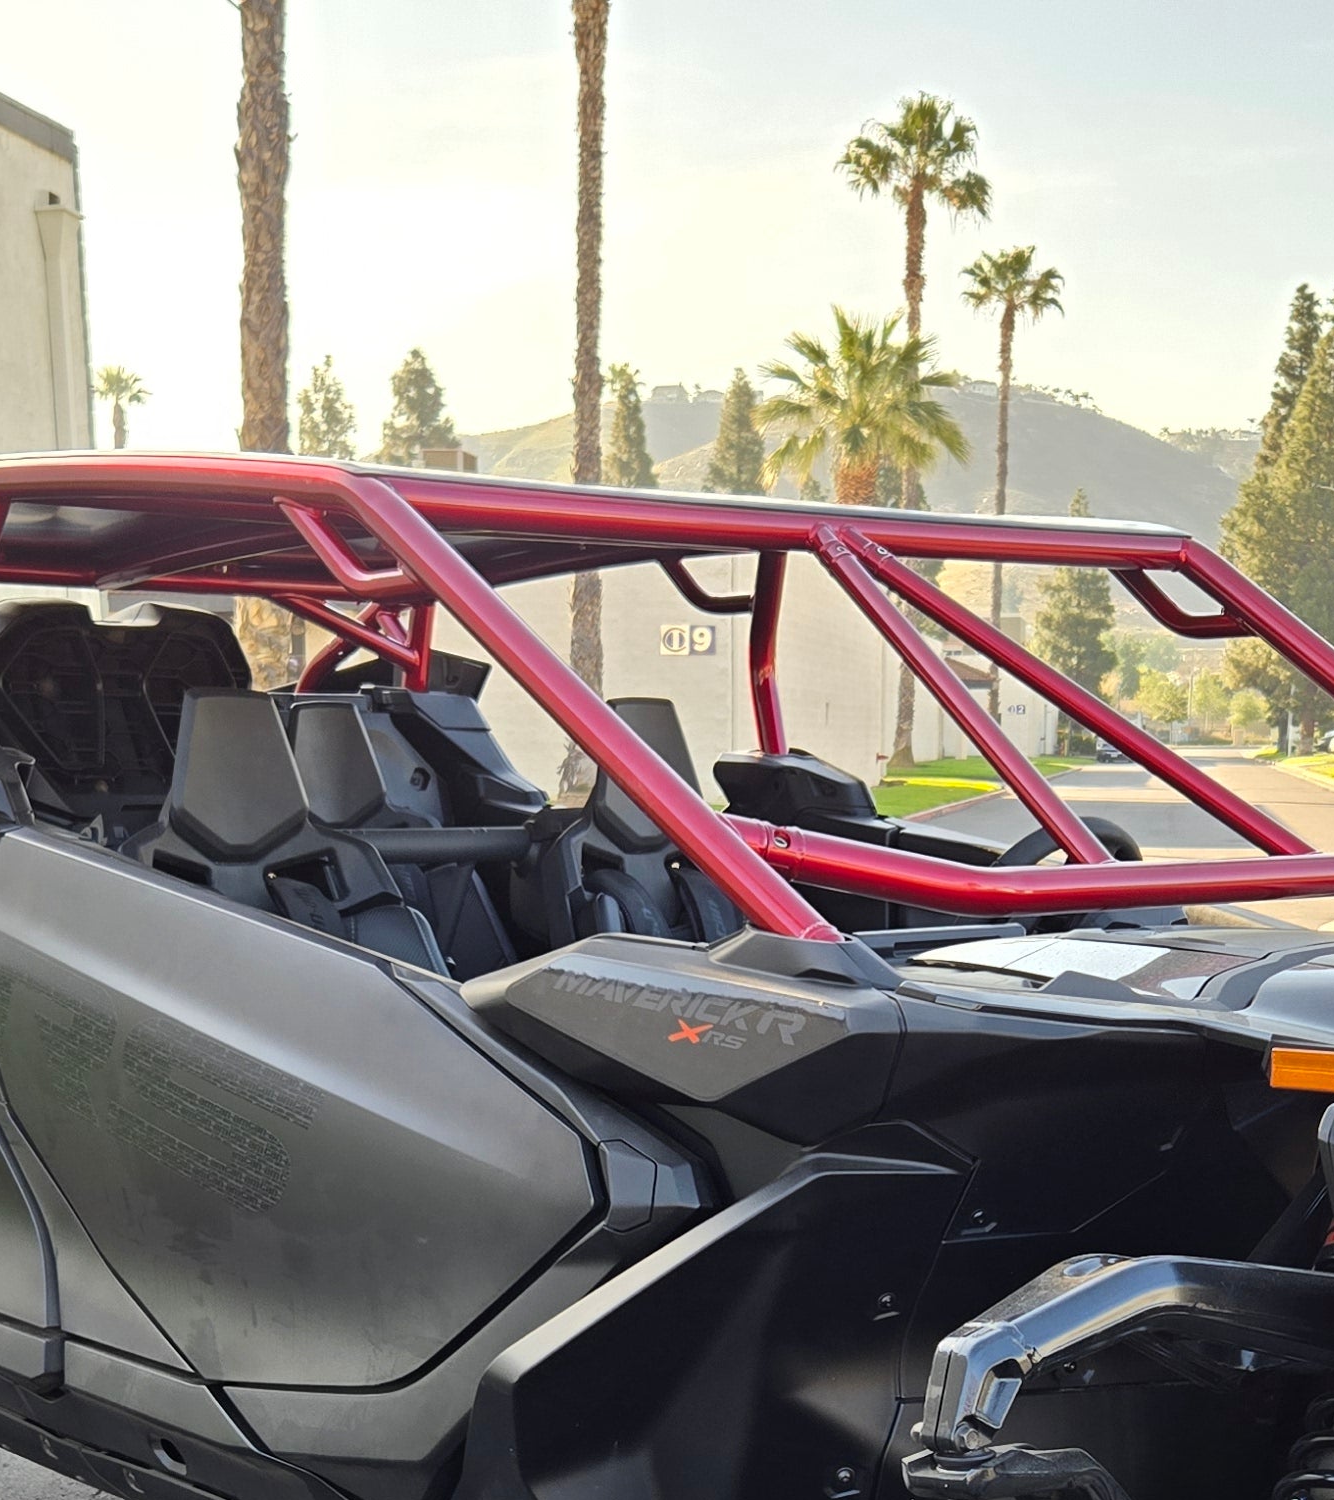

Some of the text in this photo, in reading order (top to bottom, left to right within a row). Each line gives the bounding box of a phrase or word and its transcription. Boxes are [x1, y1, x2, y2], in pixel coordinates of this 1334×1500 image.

[691, 625, 713, 653] 9
[553, 969, 806, 1046] MAVERICK R
